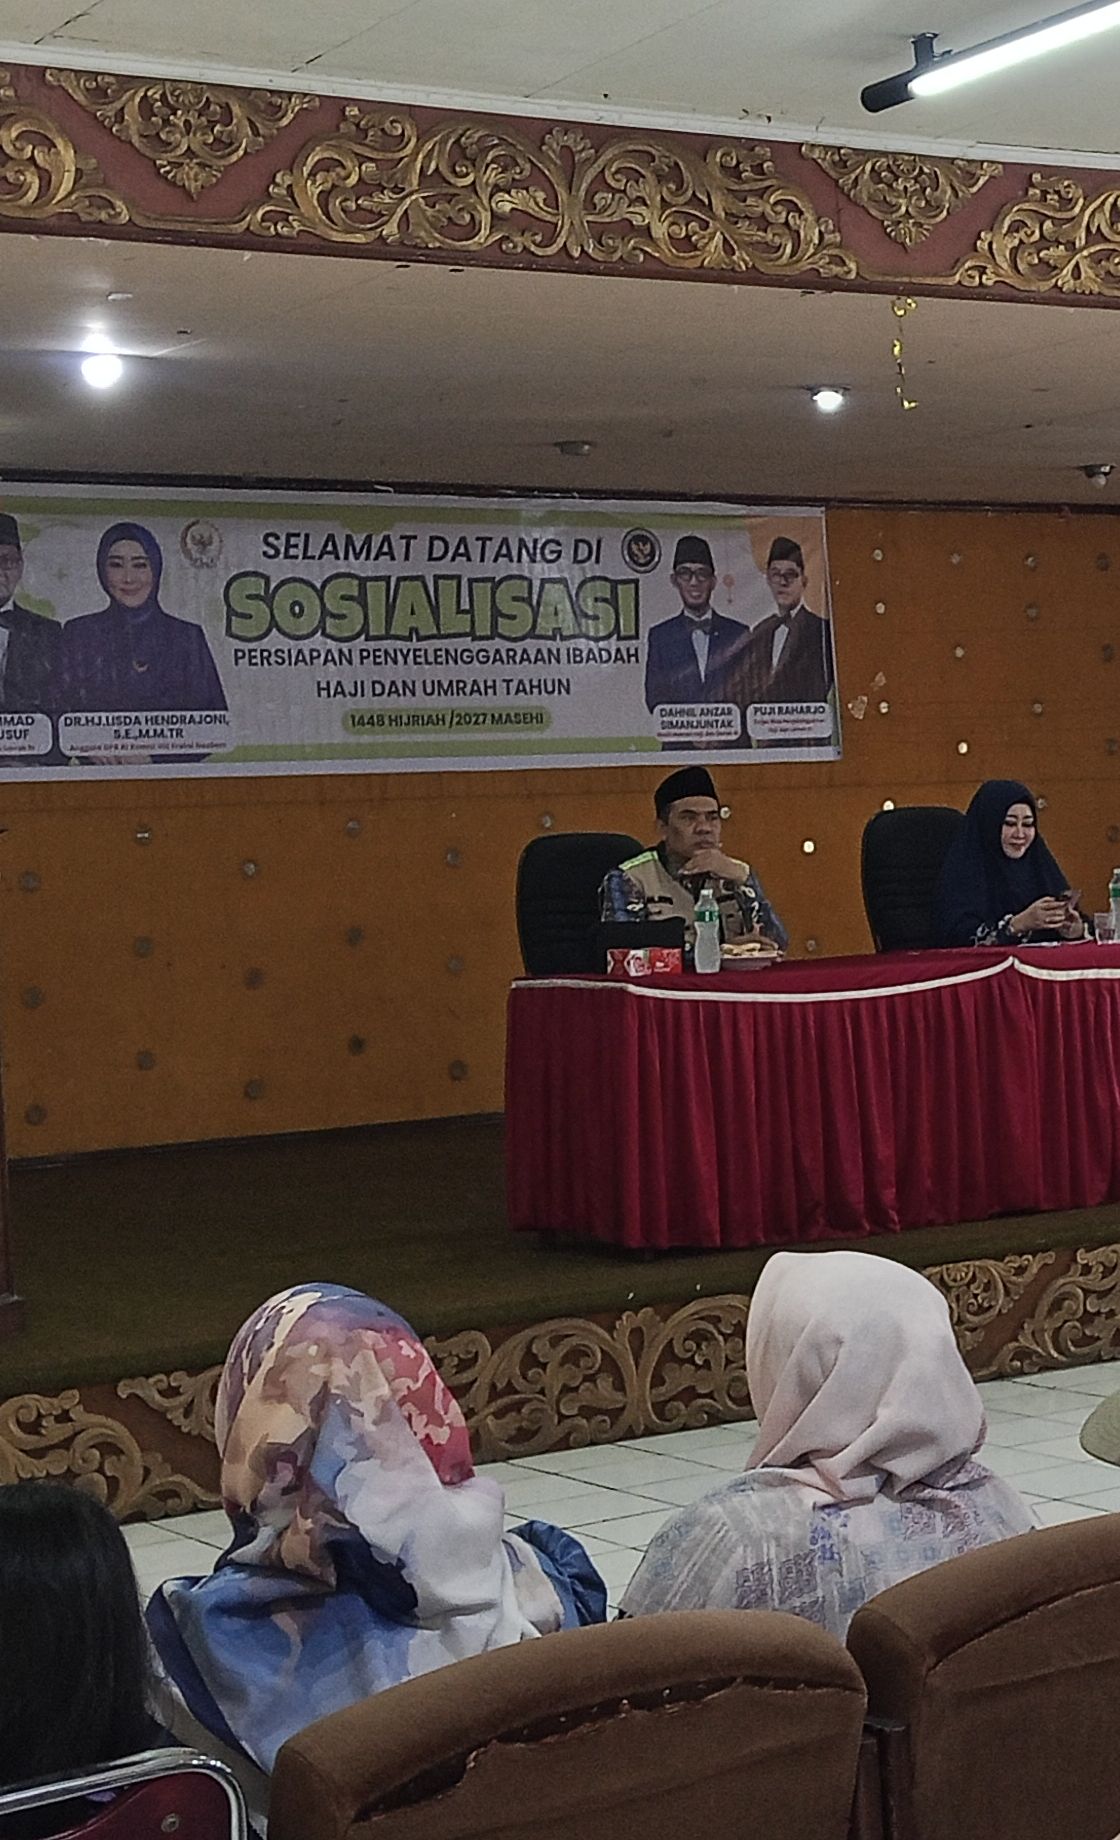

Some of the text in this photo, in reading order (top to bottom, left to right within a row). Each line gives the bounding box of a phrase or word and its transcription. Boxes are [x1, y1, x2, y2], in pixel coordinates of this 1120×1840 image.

[262, 532, 603, 565] SELAMAT DATANG DI
[223, 570, 640, 643] SOSIALISASI
[234, 647, 640, 667] PERSIAPAN PENYELENGGARAAN IBADAH
[316, 678, 571, 698] HAJI DAN UMRAH TAHUN
[660, 706, 733, 718] DAHNIL ANZAR
[753, 704, 826, 716] PUJI RAHARJO
[351, 714, 386, 728] 1448
[388, 713, 446, 728] HIJRIAH
[490, 712, 544, 726] MASEHI
[660, 719, 735, 730] SIMANJUNTAK
